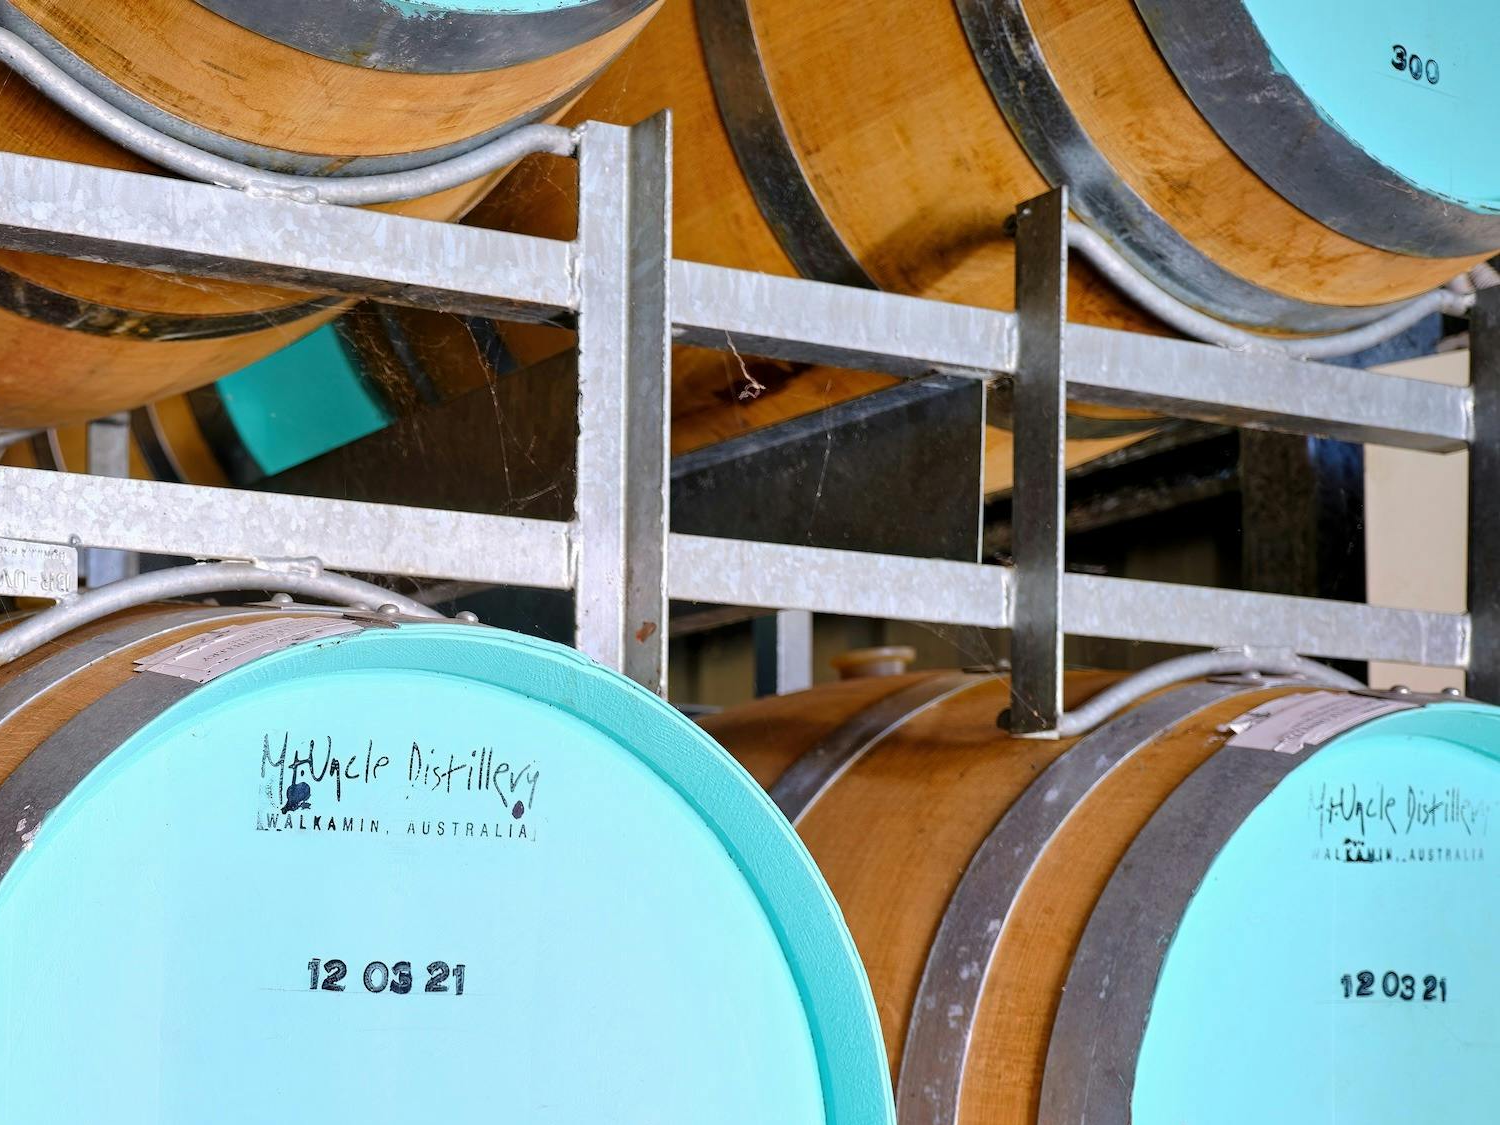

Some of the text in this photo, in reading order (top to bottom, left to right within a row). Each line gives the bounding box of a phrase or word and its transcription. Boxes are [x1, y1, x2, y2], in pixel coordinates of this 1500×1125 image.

[1391, 44, 1440, 85] 300
[407, 741, 541, 810] Distillery
[407, 820, 527, 838] AUSTRALIA
[1409, 848, 1485, 862] AUSTRALIA
